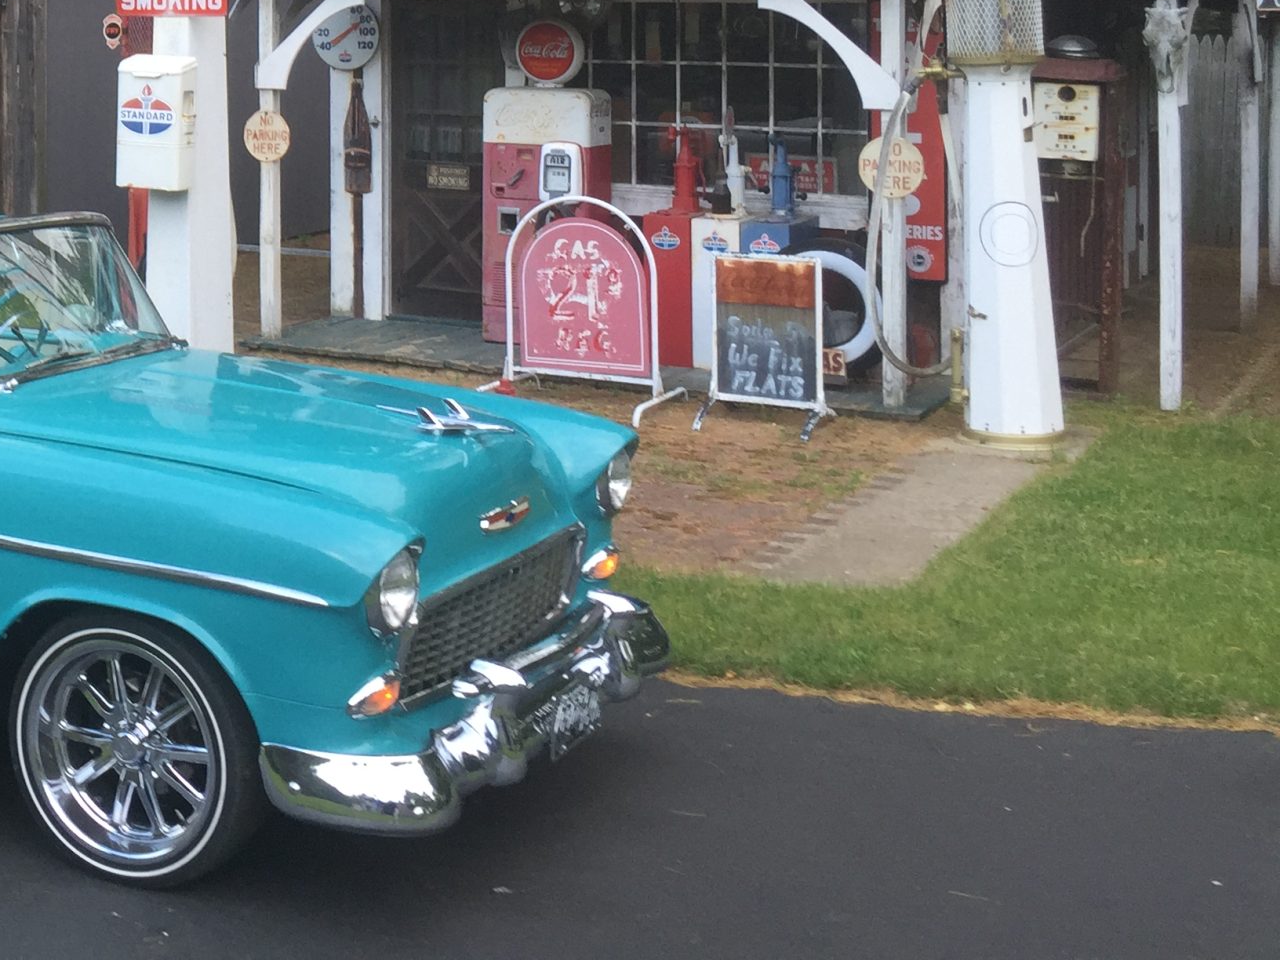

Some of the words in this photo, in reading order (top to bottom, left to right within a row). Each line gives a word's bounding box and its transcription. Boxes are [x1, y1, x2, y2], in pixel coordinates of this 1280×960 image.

[359, 27, 376, 36] 100
[357, 41, 374, 50] 120
[121, 110, 173, 121] STANDARD
[260, 116, 274, 126] NO
[246, 128, 288, 142] PARKING
[253, 143, 281, 154] HERE
[550, 156, 566, 165] AIR
[863, 159, 921, 174] PAKING
[439, 176, 469, 187] SMOKING
[873, 176, 911, 190] ERE
[728, 343, 759, 367] We
[767, 342, 803, 372] Fix
[731, 370, 805, 398] FLATS
